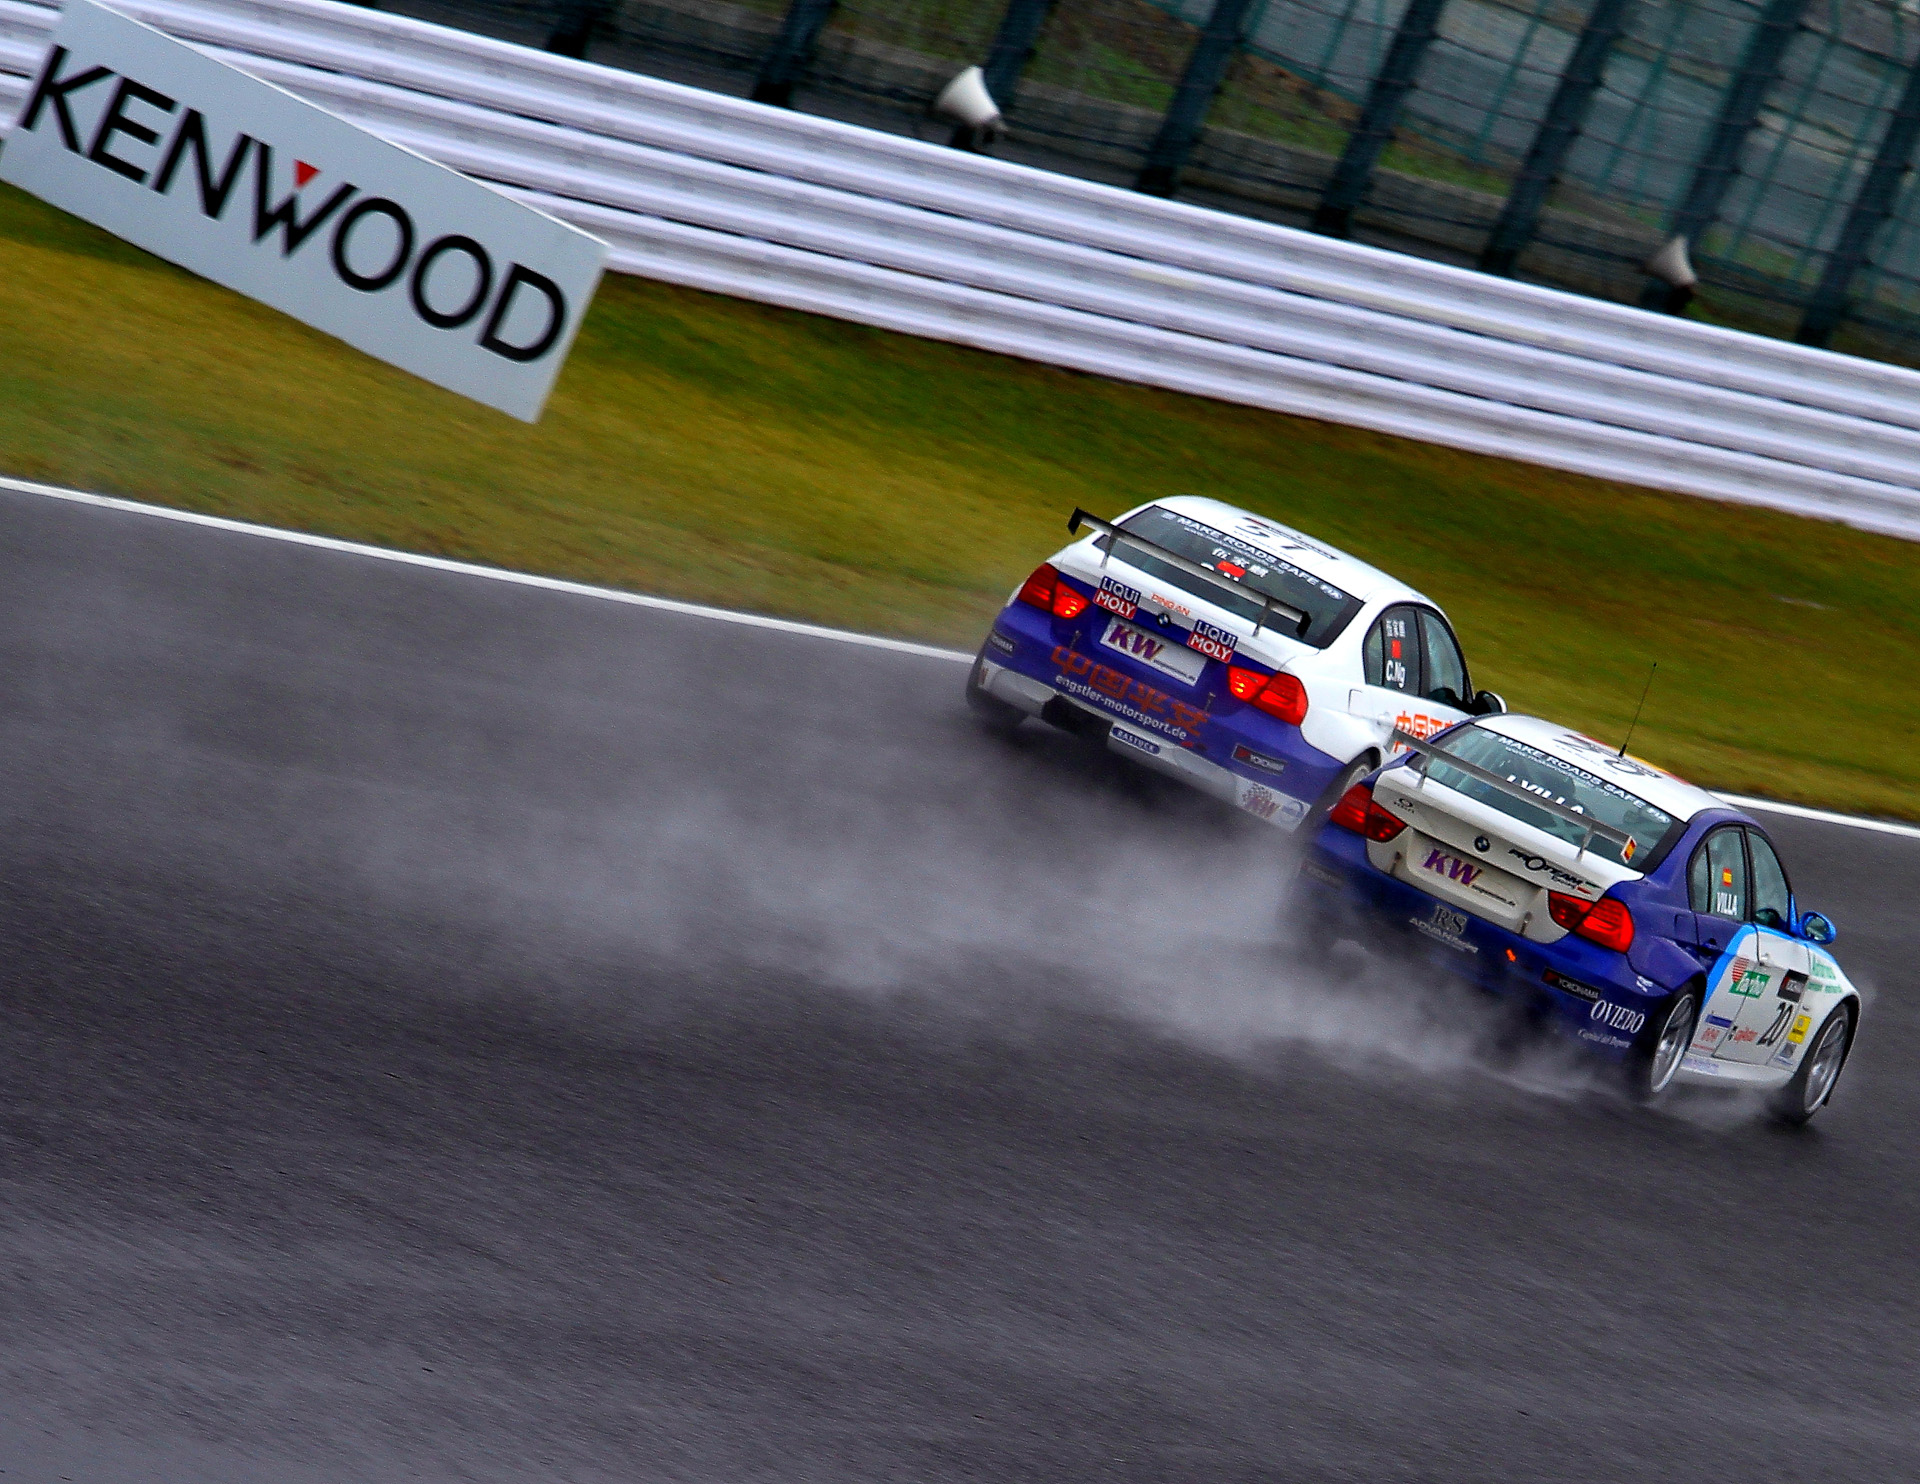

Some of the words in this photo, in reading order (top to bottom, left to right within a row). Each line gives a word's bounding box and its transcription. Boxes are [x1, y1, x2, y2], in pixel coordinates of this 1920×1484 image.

[18, 44, 567, 363] KENWOOD
[1177, 516, 1222, 540] MAKE
[1223, 536, 1278, 563] ROADS
[1278, 561, 1319, 587] SAFE
[1096, 591, 1135, 617] MOLY
[1101, 577, 1139, 604] LIQUI
[1108, 622, 1164, 660] KW
[1190, 634, 1231, 660] MOLY
[1196, 621, 1236, 648] LIQUI
[1055, 674, 1188, 741] engstler-motorsport.de
[1116, 727, 1156, 751] BASTUCK
[1498, 736, 1546, 760] MAKE
[1546, 756, 1603, 786] ROADS
[1603, 784, 1647, 809] SAFE
[1422, 848, 1482, 888] KW
[1432, 904, 1468, 935] RS
[1717, 891, 1738, 916] VILLA
[1590, 999, 1645, 1034] OVIEDO
[1757, 1002, 1793, 1047] 20
